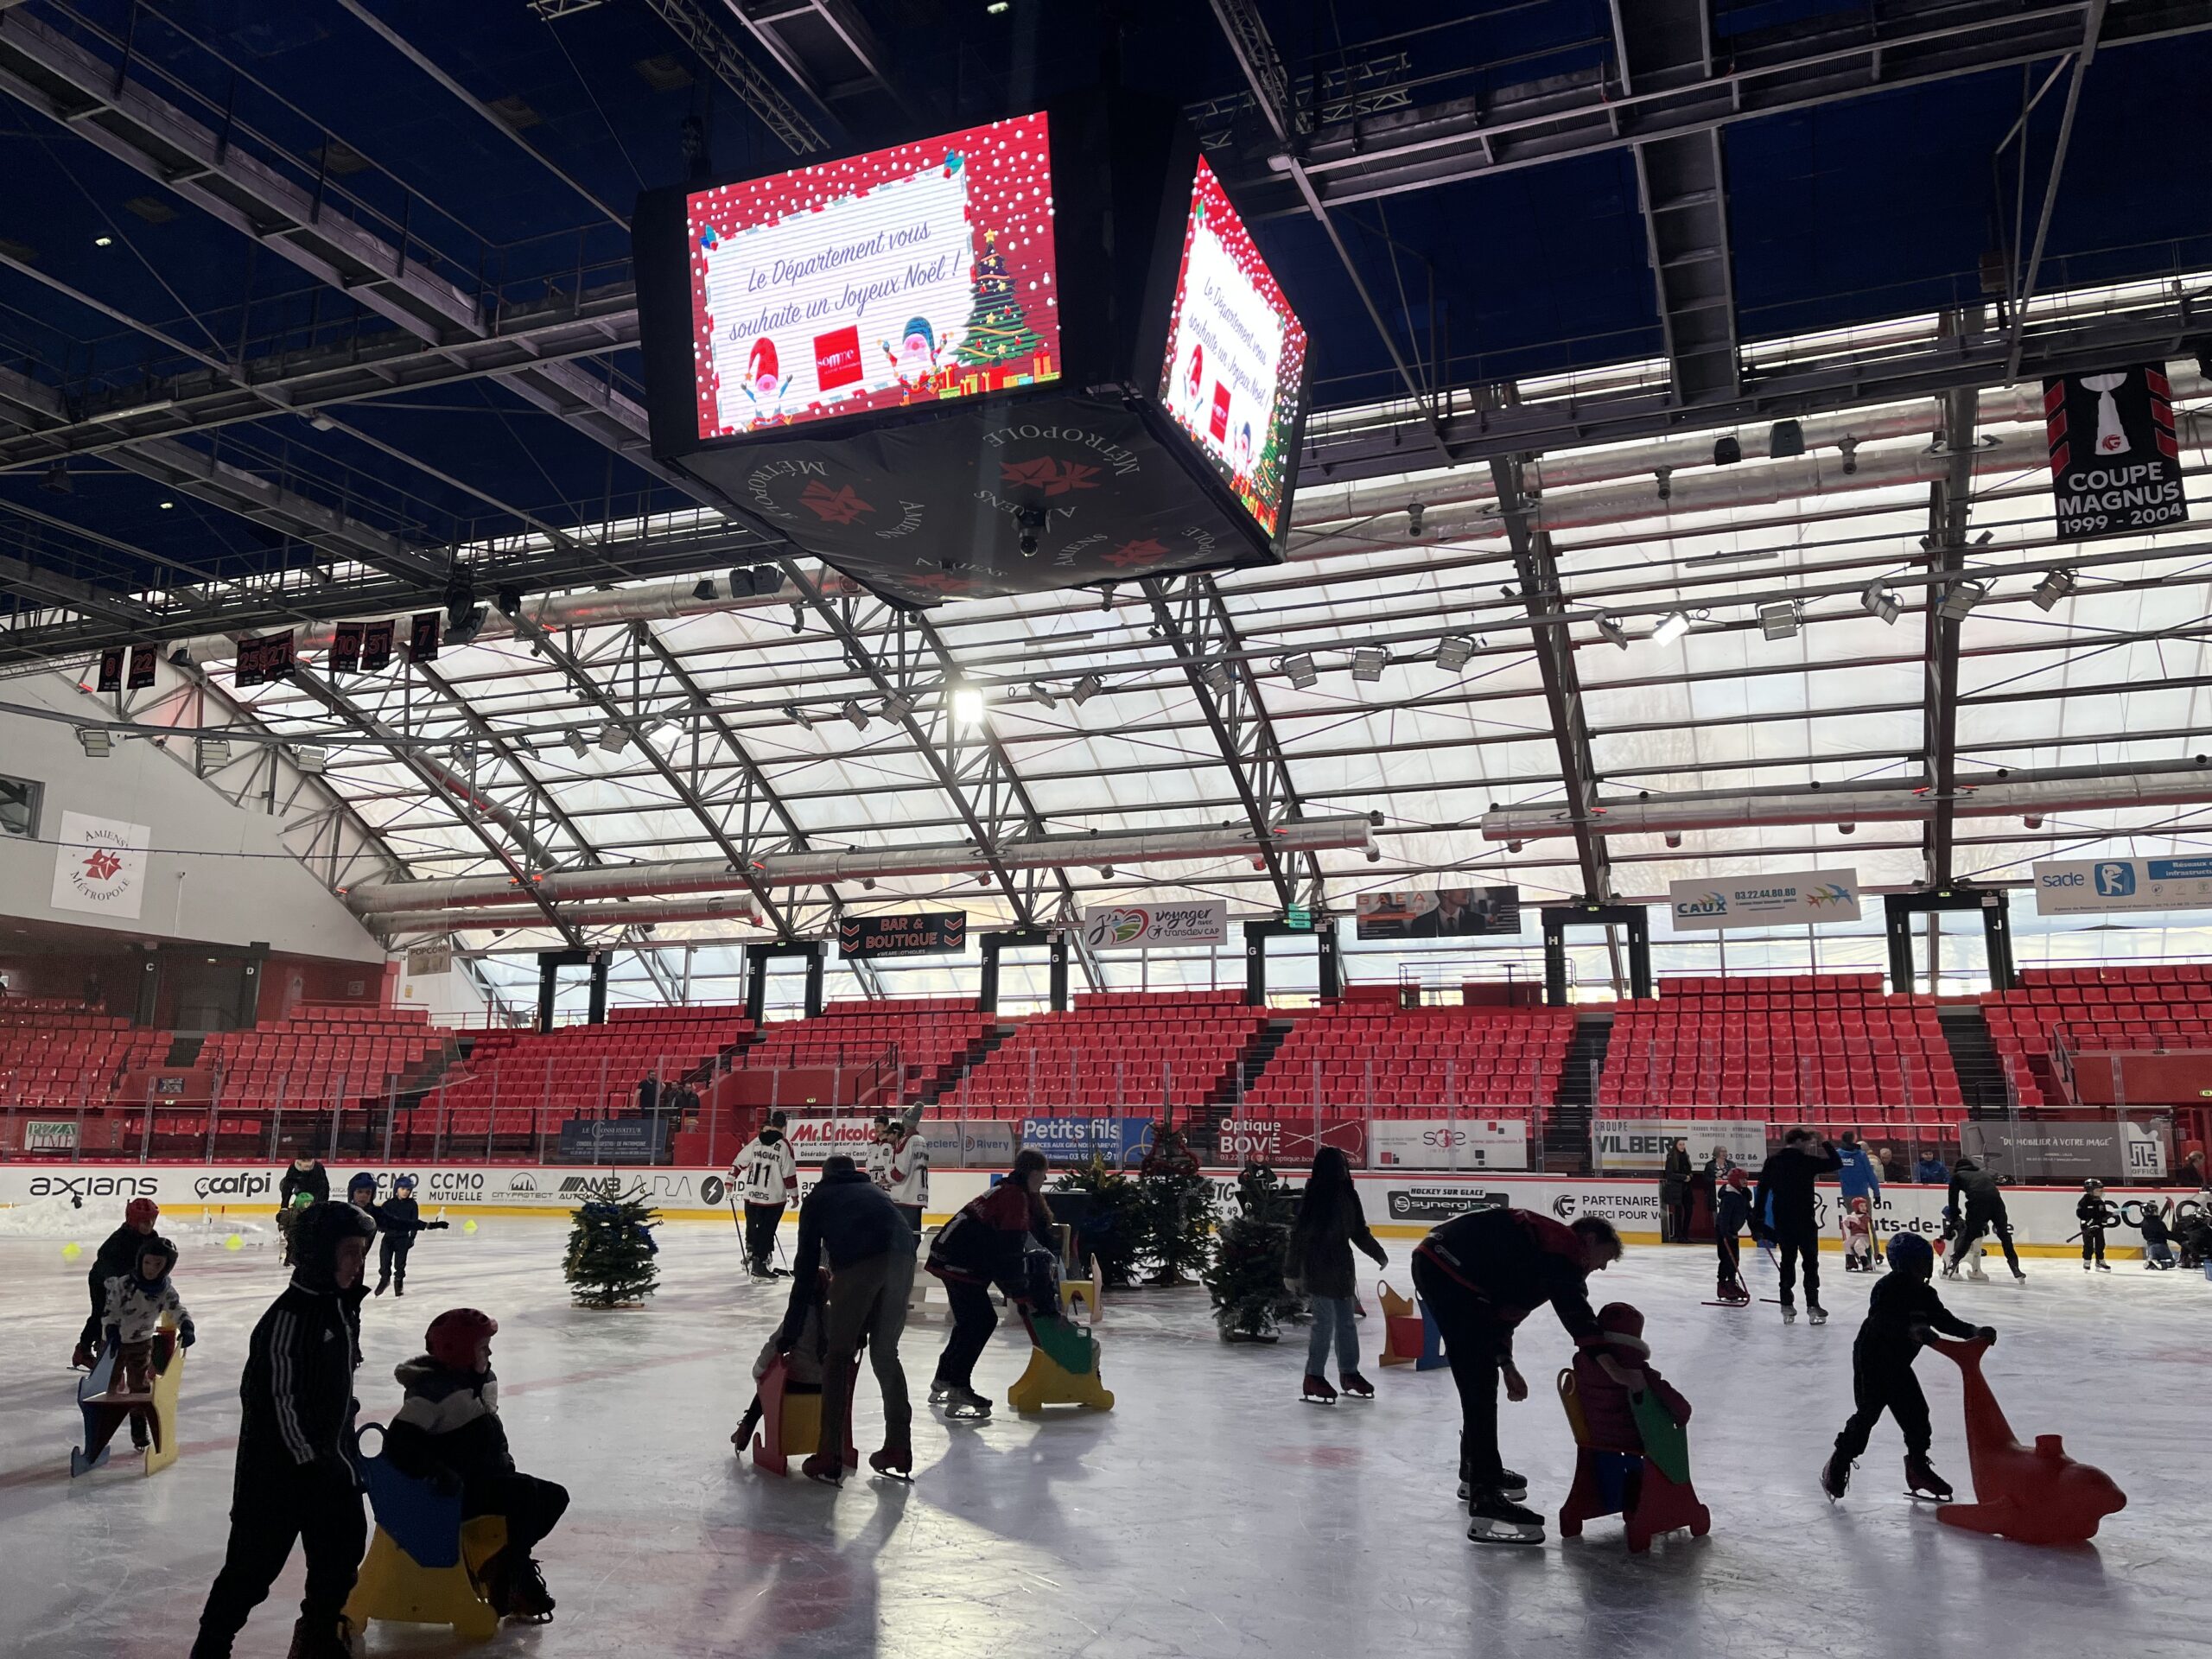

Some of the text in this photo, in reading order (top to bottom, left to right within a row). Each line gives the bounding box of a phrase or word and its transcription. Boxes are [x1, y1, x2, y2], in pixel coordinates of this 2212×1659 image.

[747, 221, 931, 292] Le Département vous
[729, 307, 802, 341] souhaite
[806, 297, 830, 319] un
[835, 276, 900, 317] Joyeux
[904, 255, 952, 290] Noël
[1213, 287, 1253, 349] Département
[1189, 312, 1218, 356] souhaite
[1228, 355, 1251, 392] Joyeux
[982, 424, 1141, 477] MÉTROPOLE
[2069, 461, 2164, 492] COUPE
[2059, 480, 2180, 516] MAGNUS
[874, 499, 925, 539] AMIENS
[2062, 515, 2108, 533] 1999
[2130, 502, 2183, 525] 2004
[418, 625, 430, 646] 7
[338, 635, 357, 655] 10
[368, 633, 388, 655] 31
[240, 651, 259, 672] 25
[268, 643, 289, 667] 27
[105, 658, 116, 677] 8
[133, 653, 153, 674] 22
[86, 830, 128, 849] AMIENS
[70, 870, 130, 901] MÉTROPOLE
[2042, 872, 2085, 887] sade
[1735, 887, 1796, 899] 03.22.44.80.80
[1677, 902, 1726, 913] CAUX
[880, 918, 924, 931] BAR &
[1154, 908, 1212, 930] voyager
[1993, 919, 2002, 931] J
[865, 931, 938, 949] BOUTIQUE
[1164, 928, 1203, 937] transdev
[1548, 936, 1558, 945] H
[410, 946, 448, 956] POPCORN
[1249, 946, 1256, 956] G
[1321, 944, 1330, 953] H
[982, 957, 988, 966] F
[1052, 954, 1059, 963] G
[145, 963, 156, 972] C
[246, 967, 255, 976] D
[749, 966, 755, 975] E
[807, 964, 813, 973] F
[540, 975, 546, 983] E
[591, 973, 597, 982] E
[30, 1123, 74, 1135] PIZZA
[1023, 1119, 1122, 1139] Petits-fils
[1220, 1118, 1281, 1135] Optique
[1594, 1121, 1628, 1132] GROUPE
[29, 1135, 72, 1147] TIME
[925, 1140, 1009, 1151] eclerc Rivery
[1220, 1134, 1281, 1154] BOVÉ
[2016, 1138, 2051, 1147] MOBILIER
[2053, 1136, 2058, 1147] À
[2059, 1138, 2085, 1147] VOTRE
[29, 1177, 158, 1196] axians
[208, 1172, 271, 1198] cafpi
[430, 1173, 484, 1190] CCMO
[429, 1191, 482, 1201] MUTUELLE
[1582, 1196, 1658, 1206] PARTENAIRE
[1227, 1206, 1238, 1215] 49
[1583, 1210, 1616, 1219] MERCI
[1618, 1211, 1649, 1220] POUR
